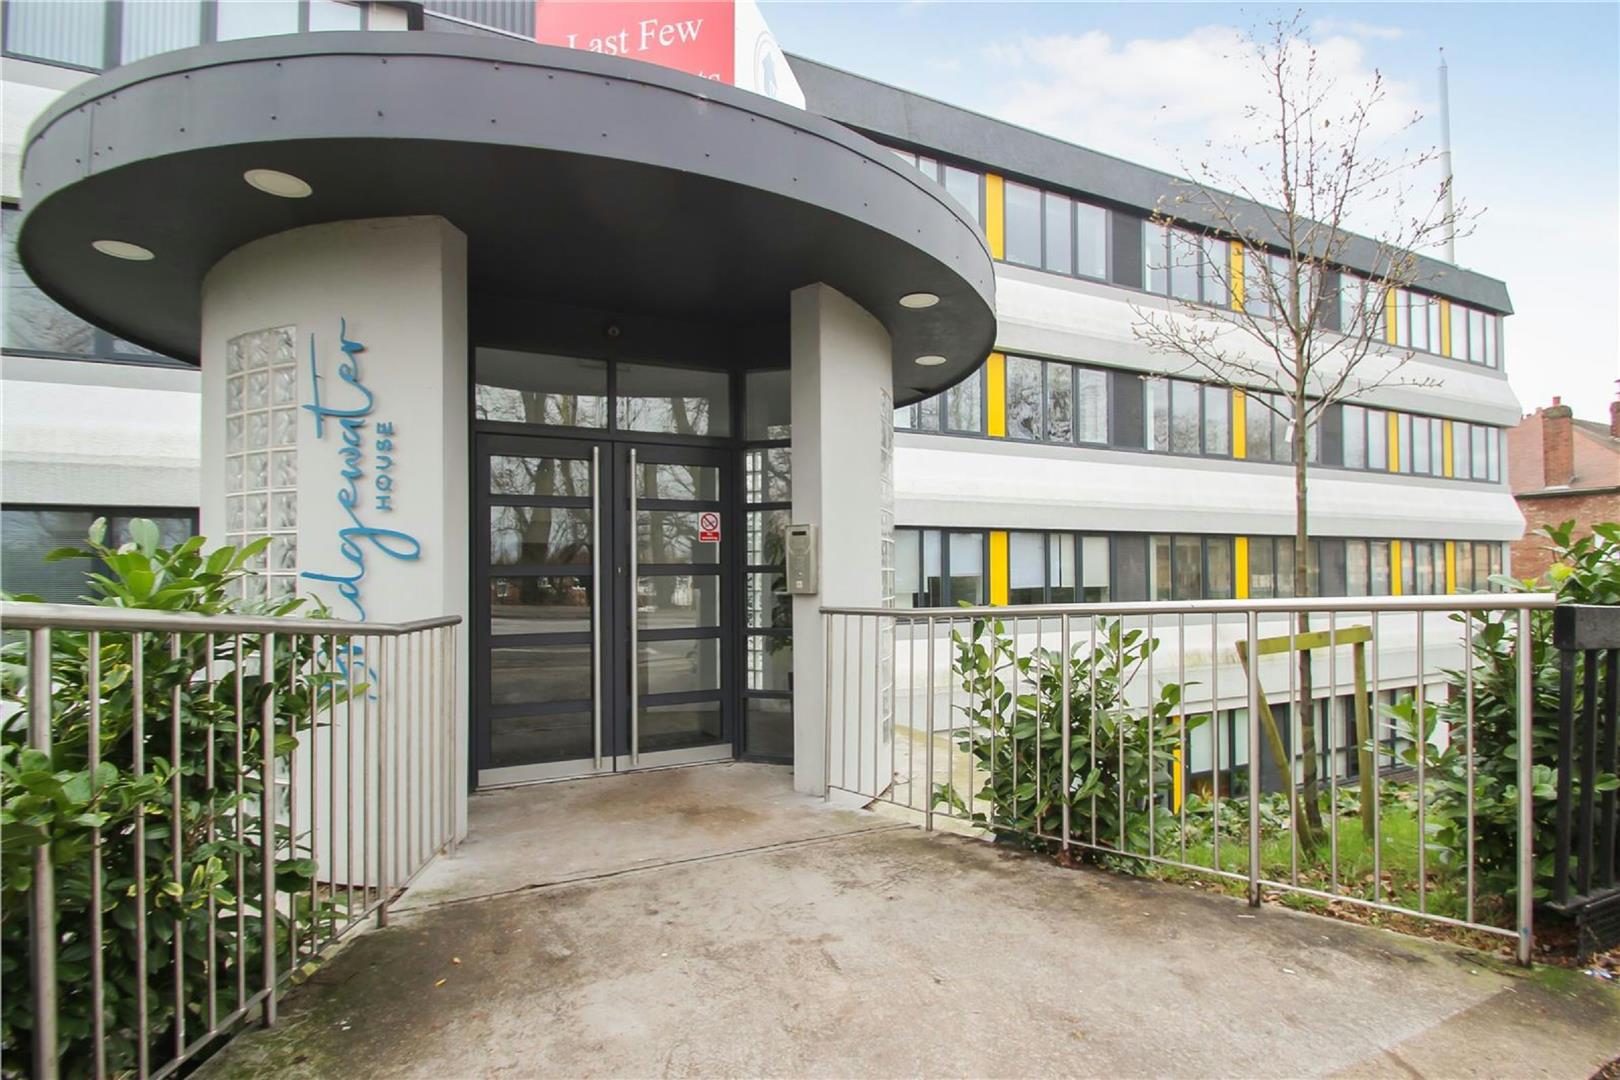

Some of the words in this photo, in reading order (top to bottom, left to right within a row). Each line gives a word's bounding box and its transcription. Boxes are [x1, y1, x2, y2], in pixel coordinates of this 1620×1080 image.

[638, 18, 704, 51] Few
[301, 316, 421, 701] dgewater
[375, 420, 396, 512] HOUSE
